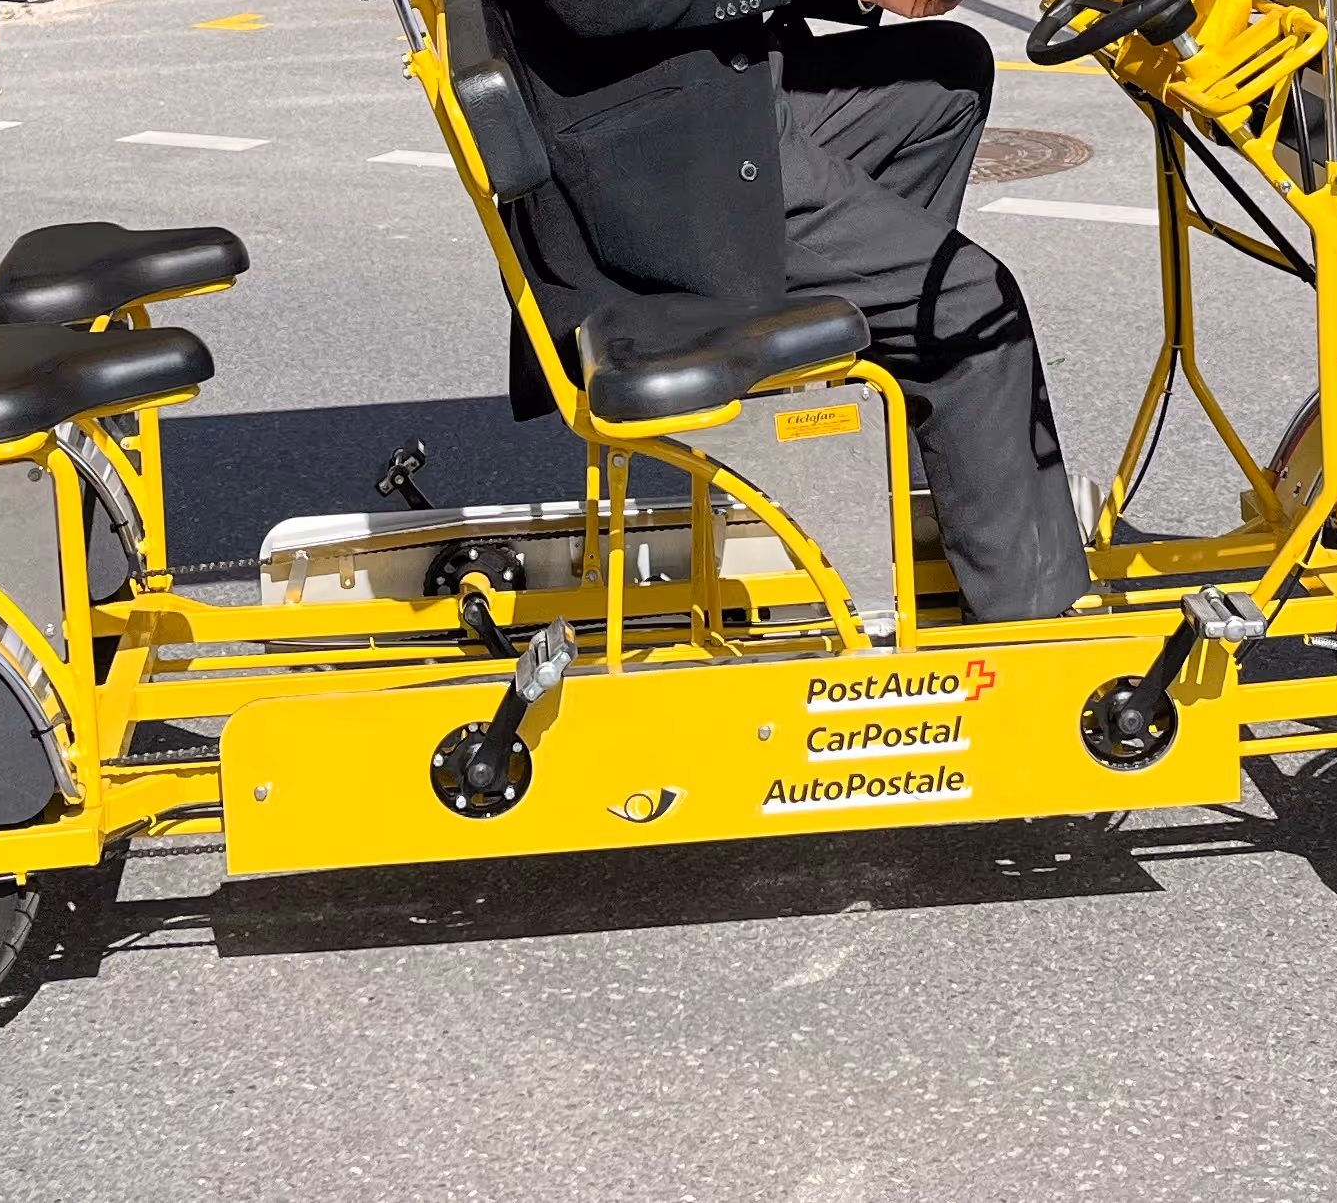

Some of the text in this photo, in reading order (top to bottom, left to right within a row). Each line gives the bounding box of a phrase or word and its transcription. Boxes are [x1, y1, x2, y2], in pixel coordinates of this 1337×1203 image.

[806, 671, 960, 704] PostAuto
[806, 715, 963, 753] CarPostal
[762, 765, 965, 806] AutoPostale
